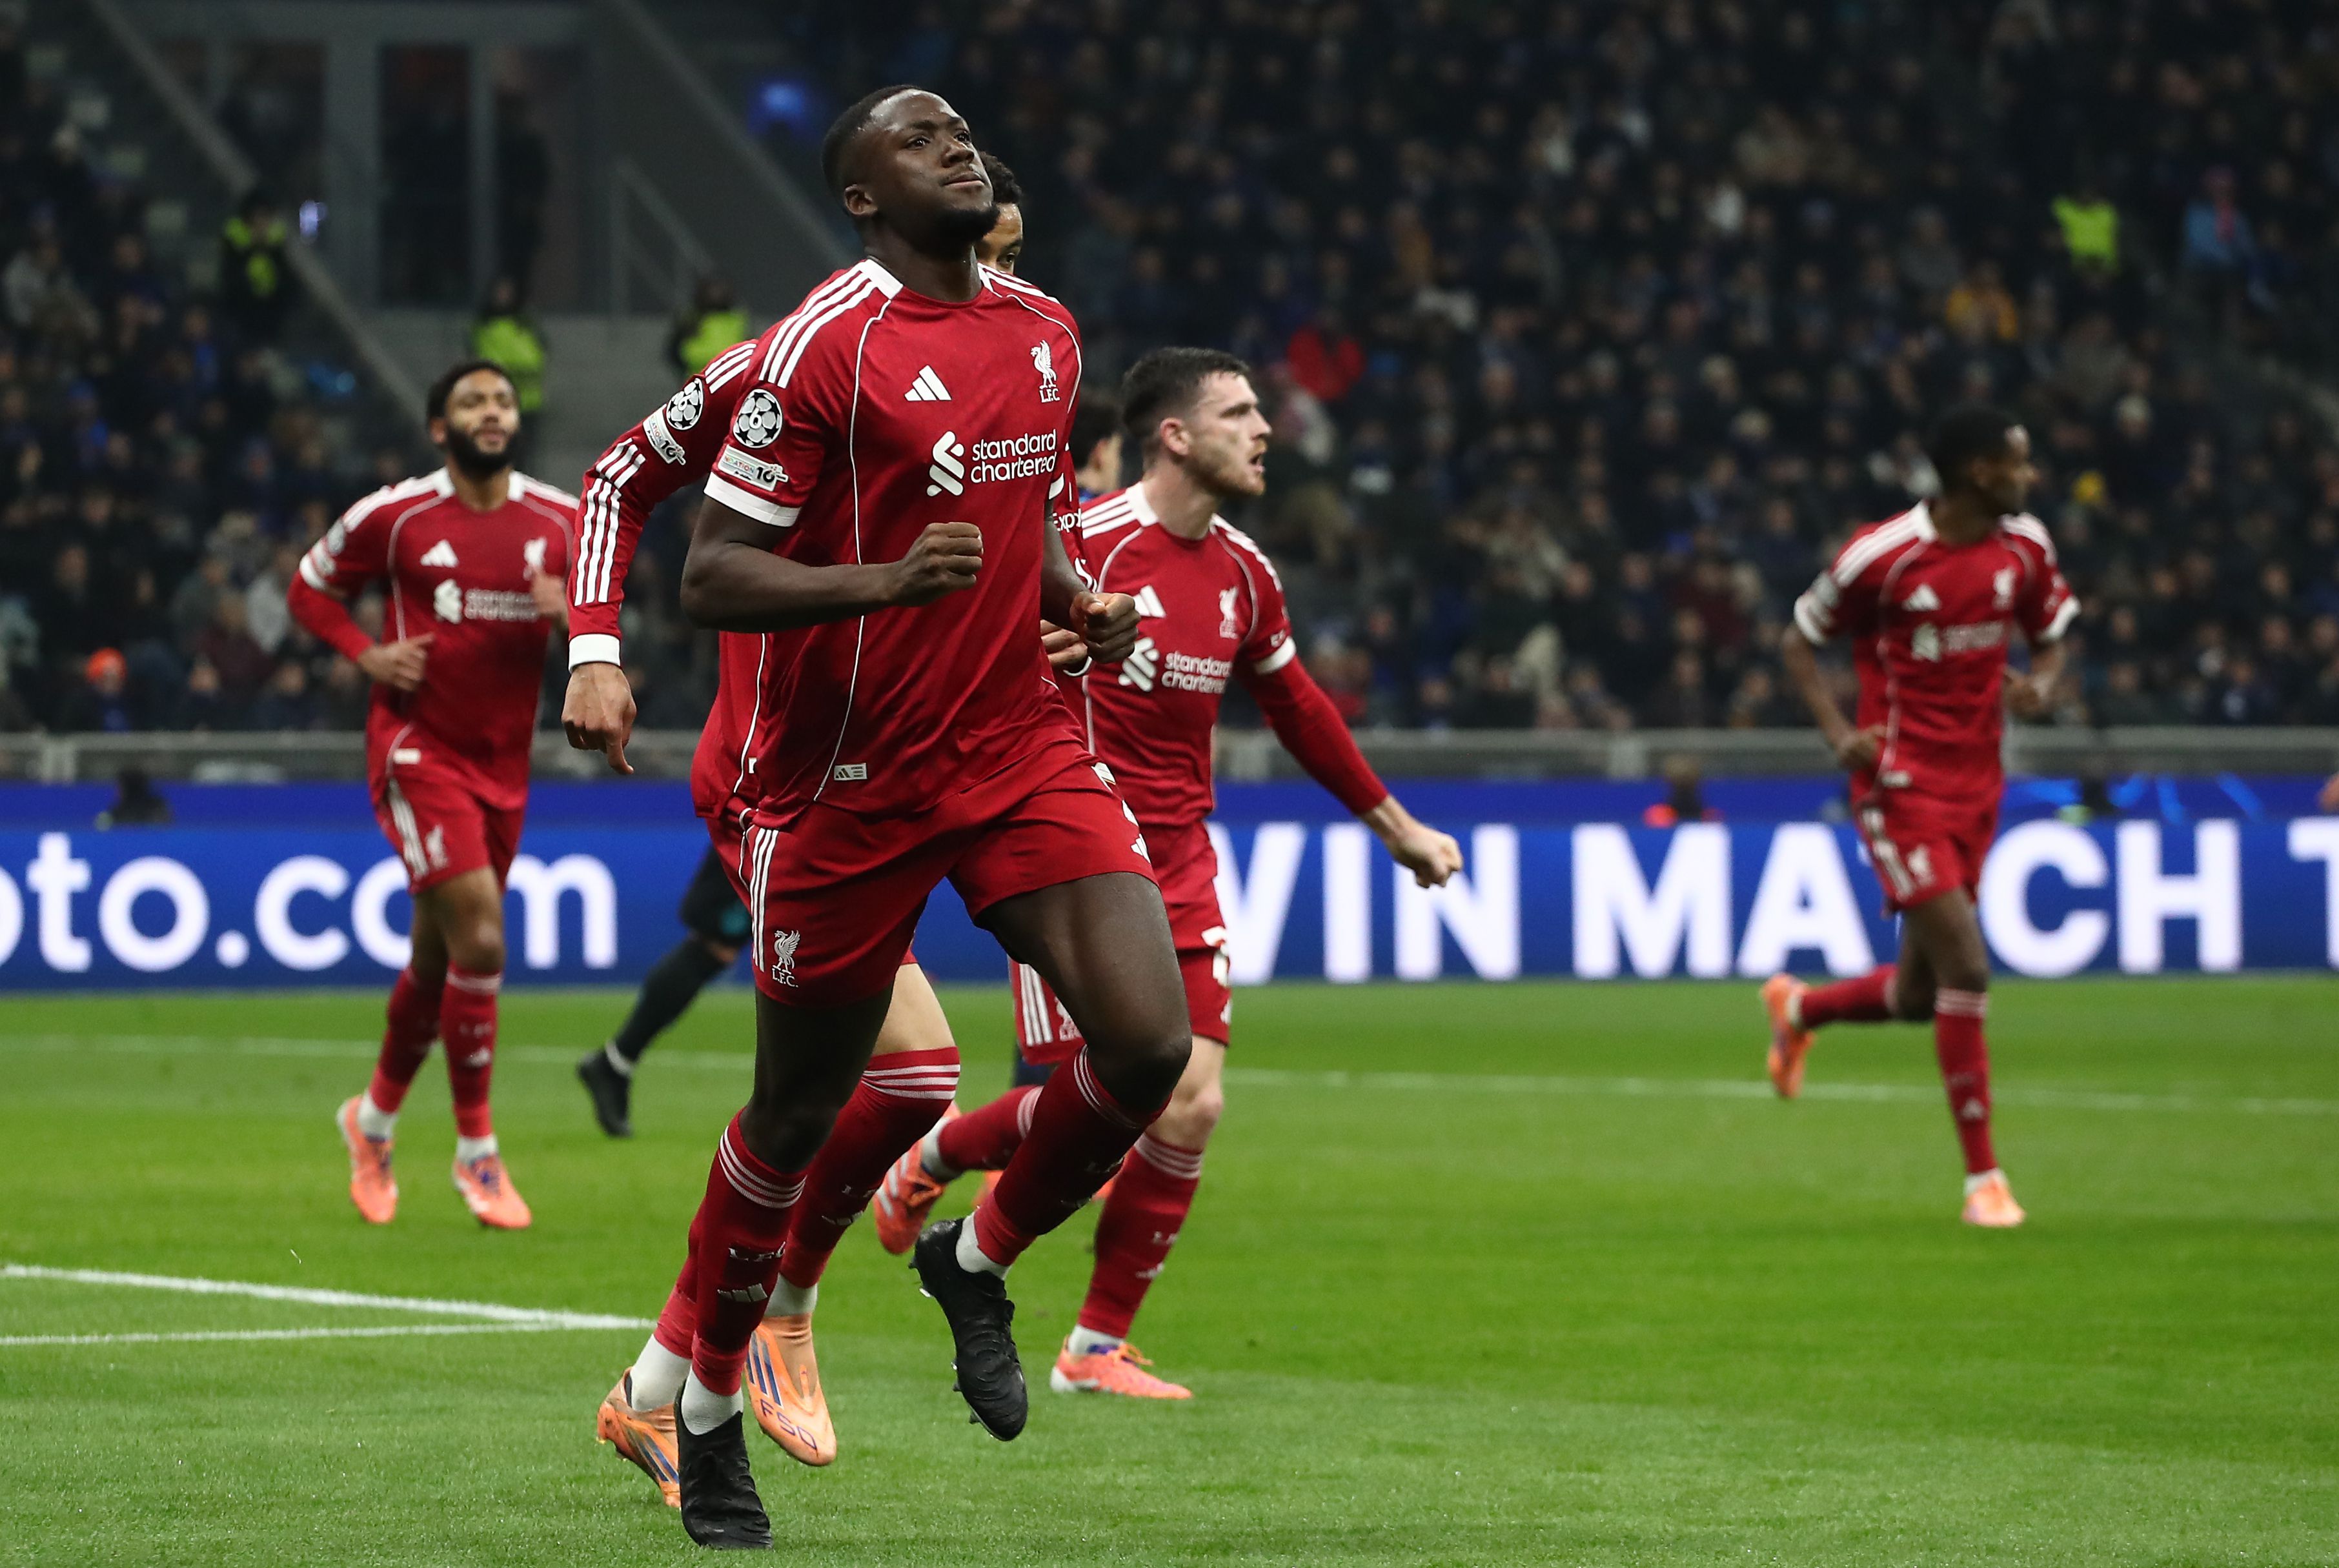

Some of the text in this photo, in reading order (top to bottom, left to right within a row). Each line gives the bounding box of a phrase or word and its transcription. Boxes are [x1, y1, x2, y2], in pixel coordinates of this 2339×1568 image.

[749, 407, 762, 429] 6
[972, 428, 1057, 461] standard
[971, 451, 1057, 483] chartered
[0, 832, 618, 973] to.com
[1570, 818, 2244, 980] MACH
